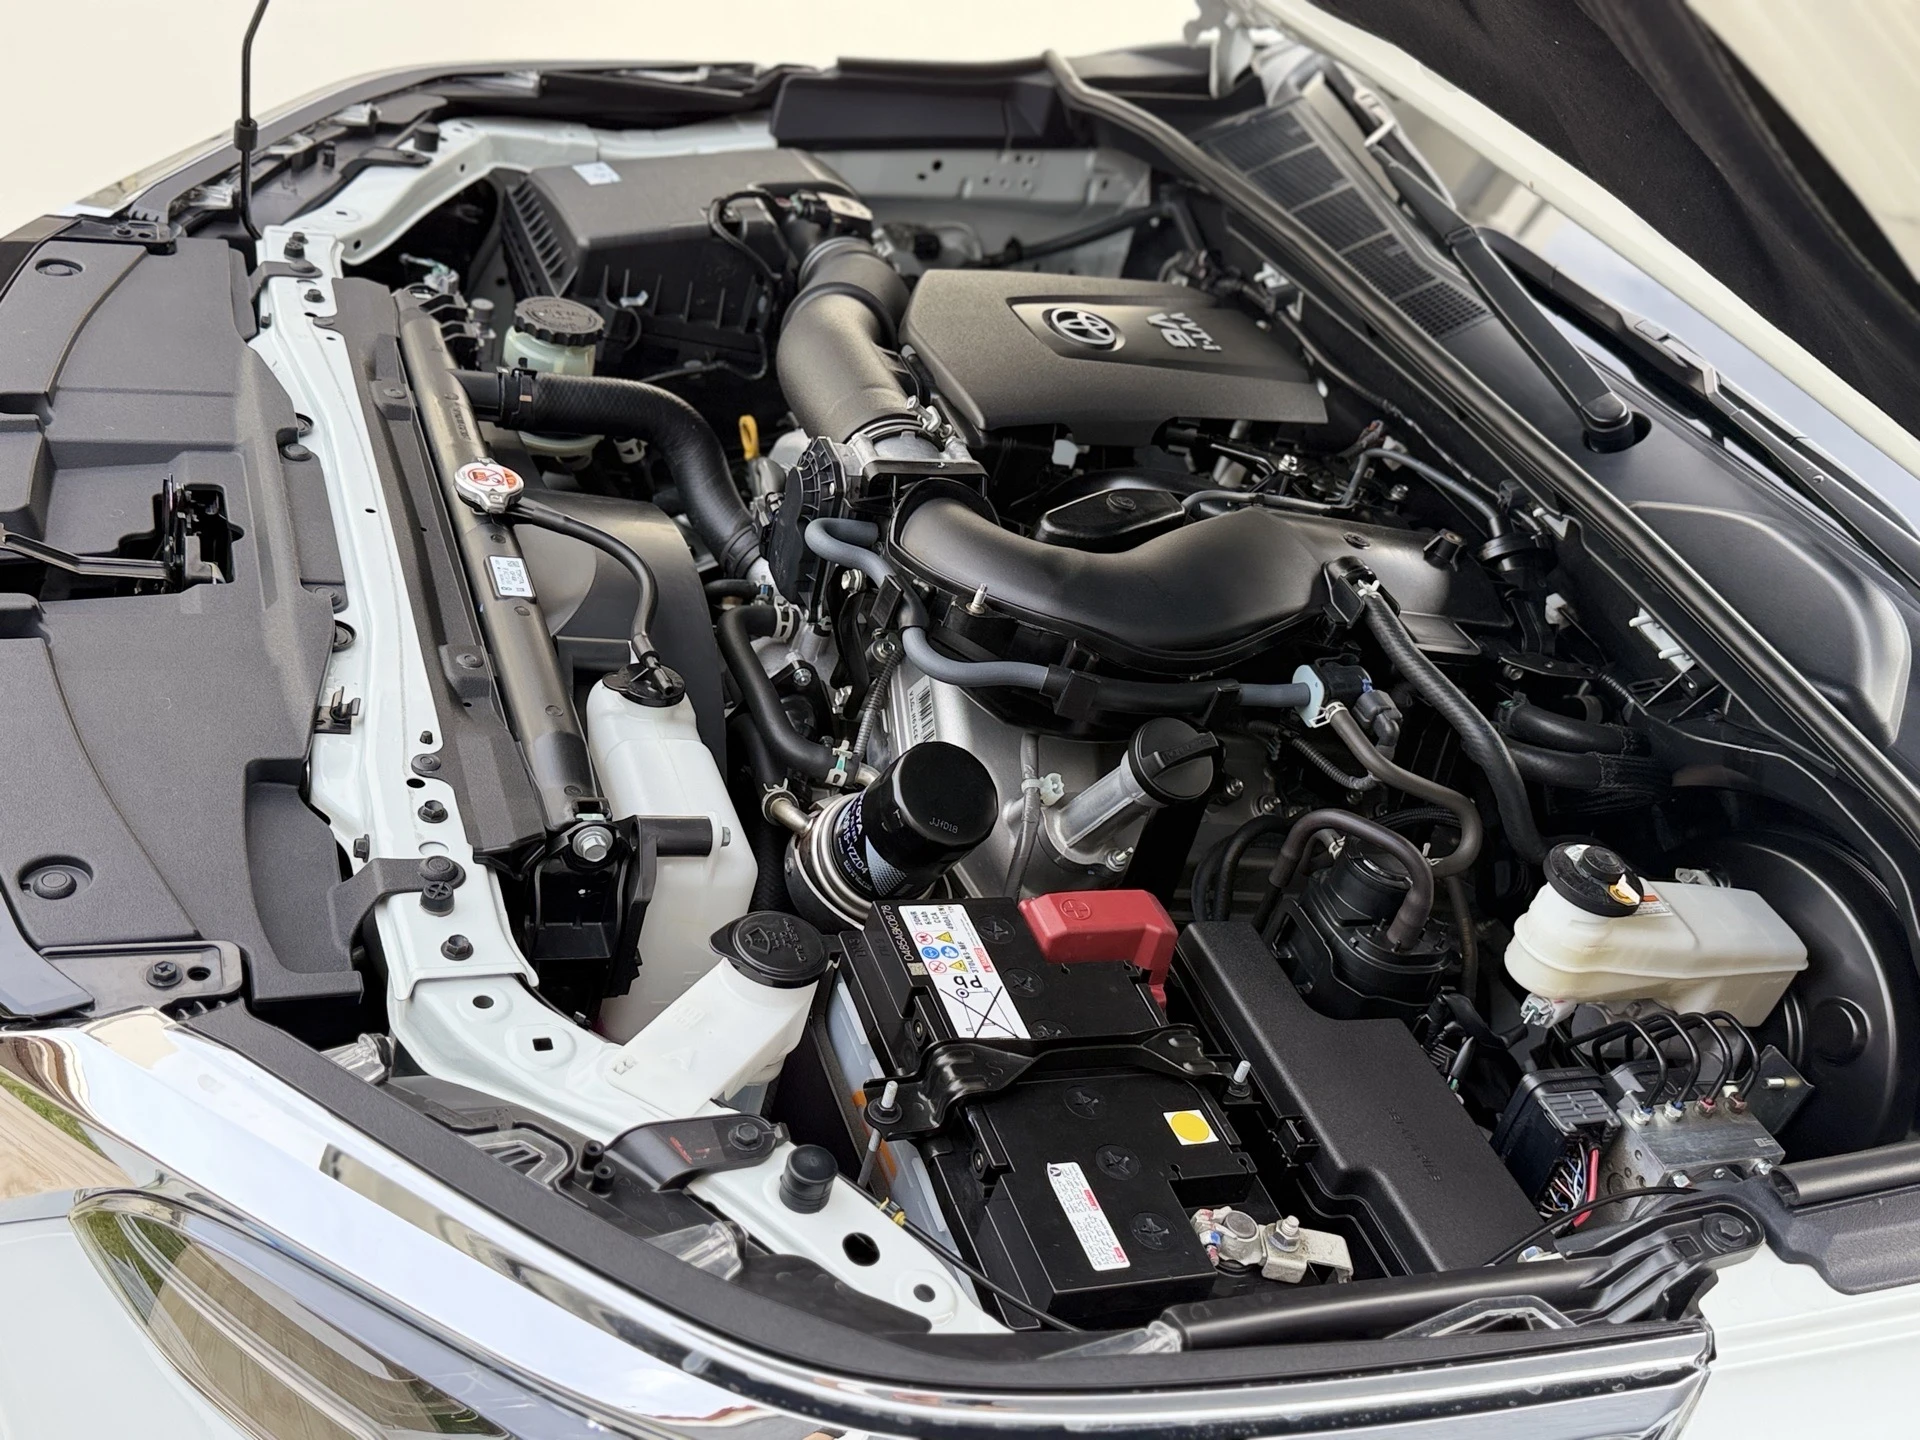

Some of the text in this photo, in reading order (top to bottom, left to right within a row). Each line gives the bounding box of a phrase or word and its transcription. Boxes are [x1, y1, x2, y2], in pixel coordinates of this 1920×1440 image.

[1146, 313, 1197, 347] V6
[1170, 312, 1222, 351] VVT-i
[953, 974, 983, 989] Pb
